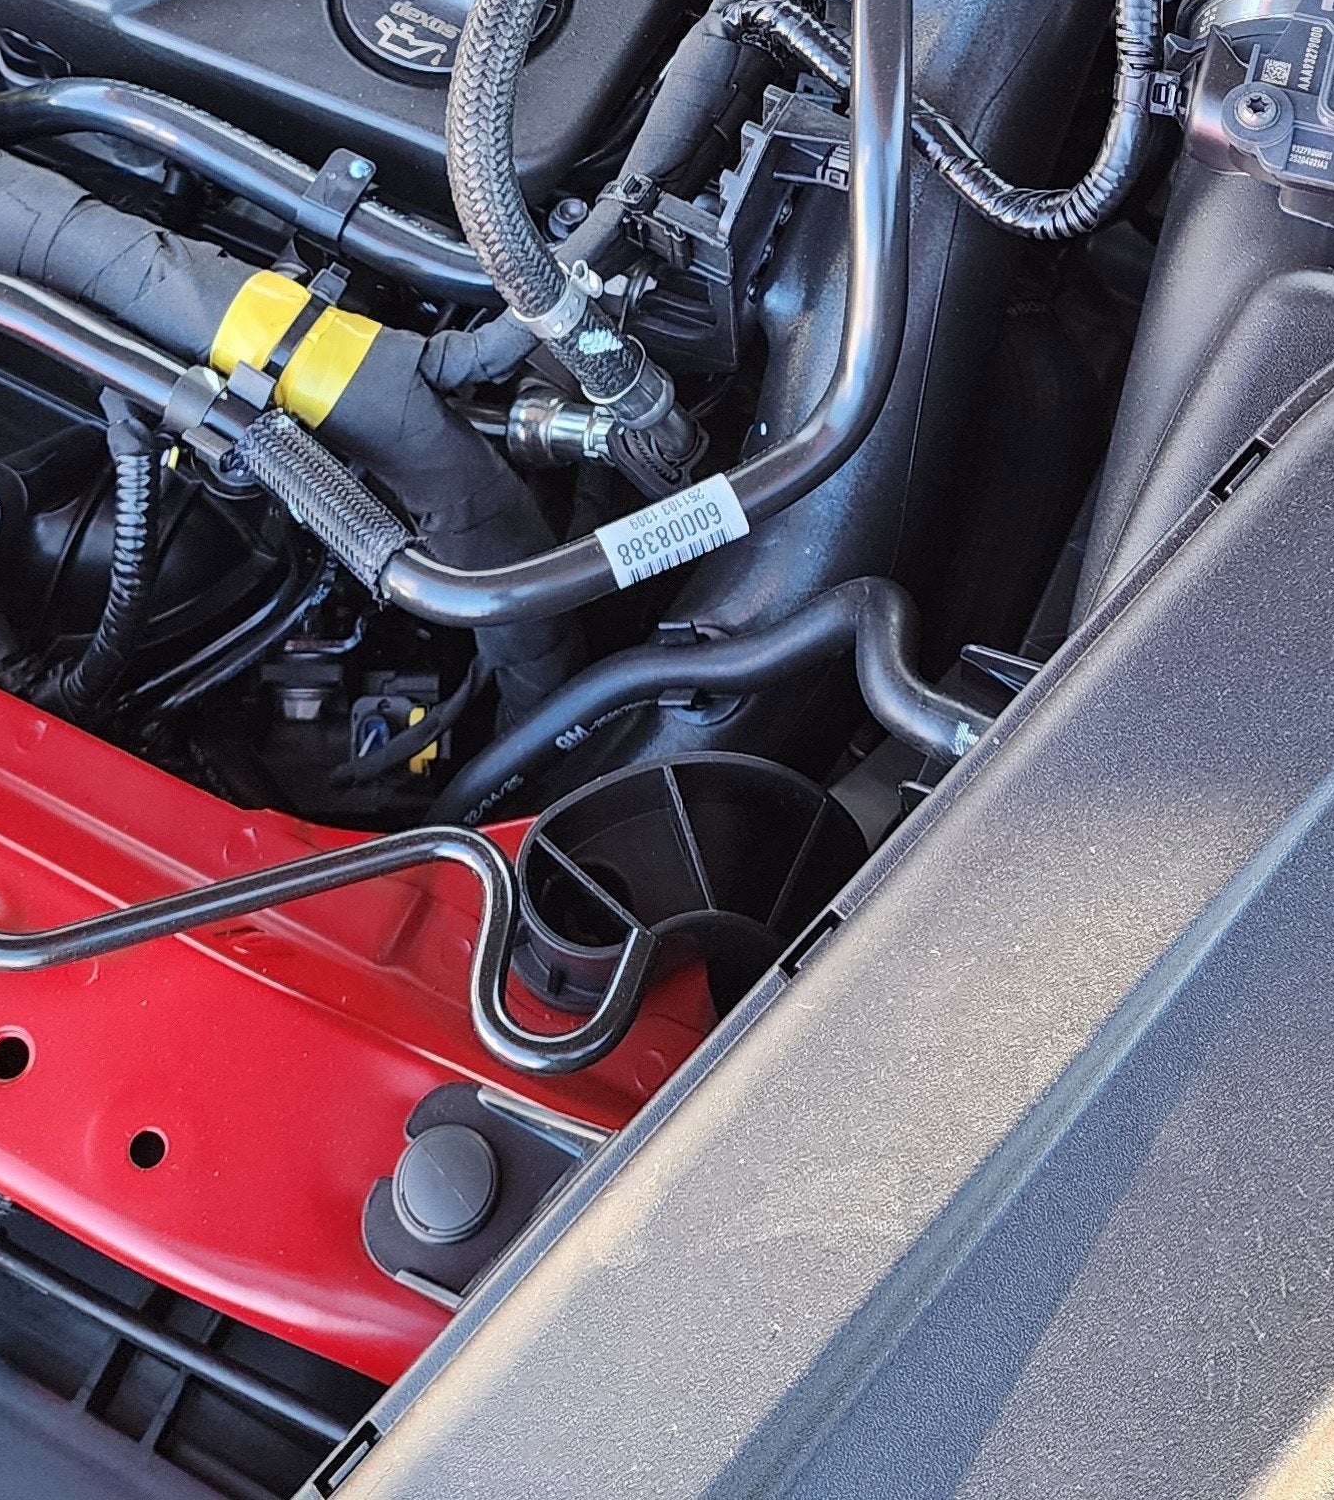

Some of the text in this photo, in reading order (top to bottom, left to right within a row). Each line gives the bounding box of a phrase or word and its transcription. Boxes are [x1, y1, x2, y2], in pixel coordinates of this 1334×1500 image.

[617, 505, 723, 568] 60008388
[627, 488, 706, 532] 251103 1309
